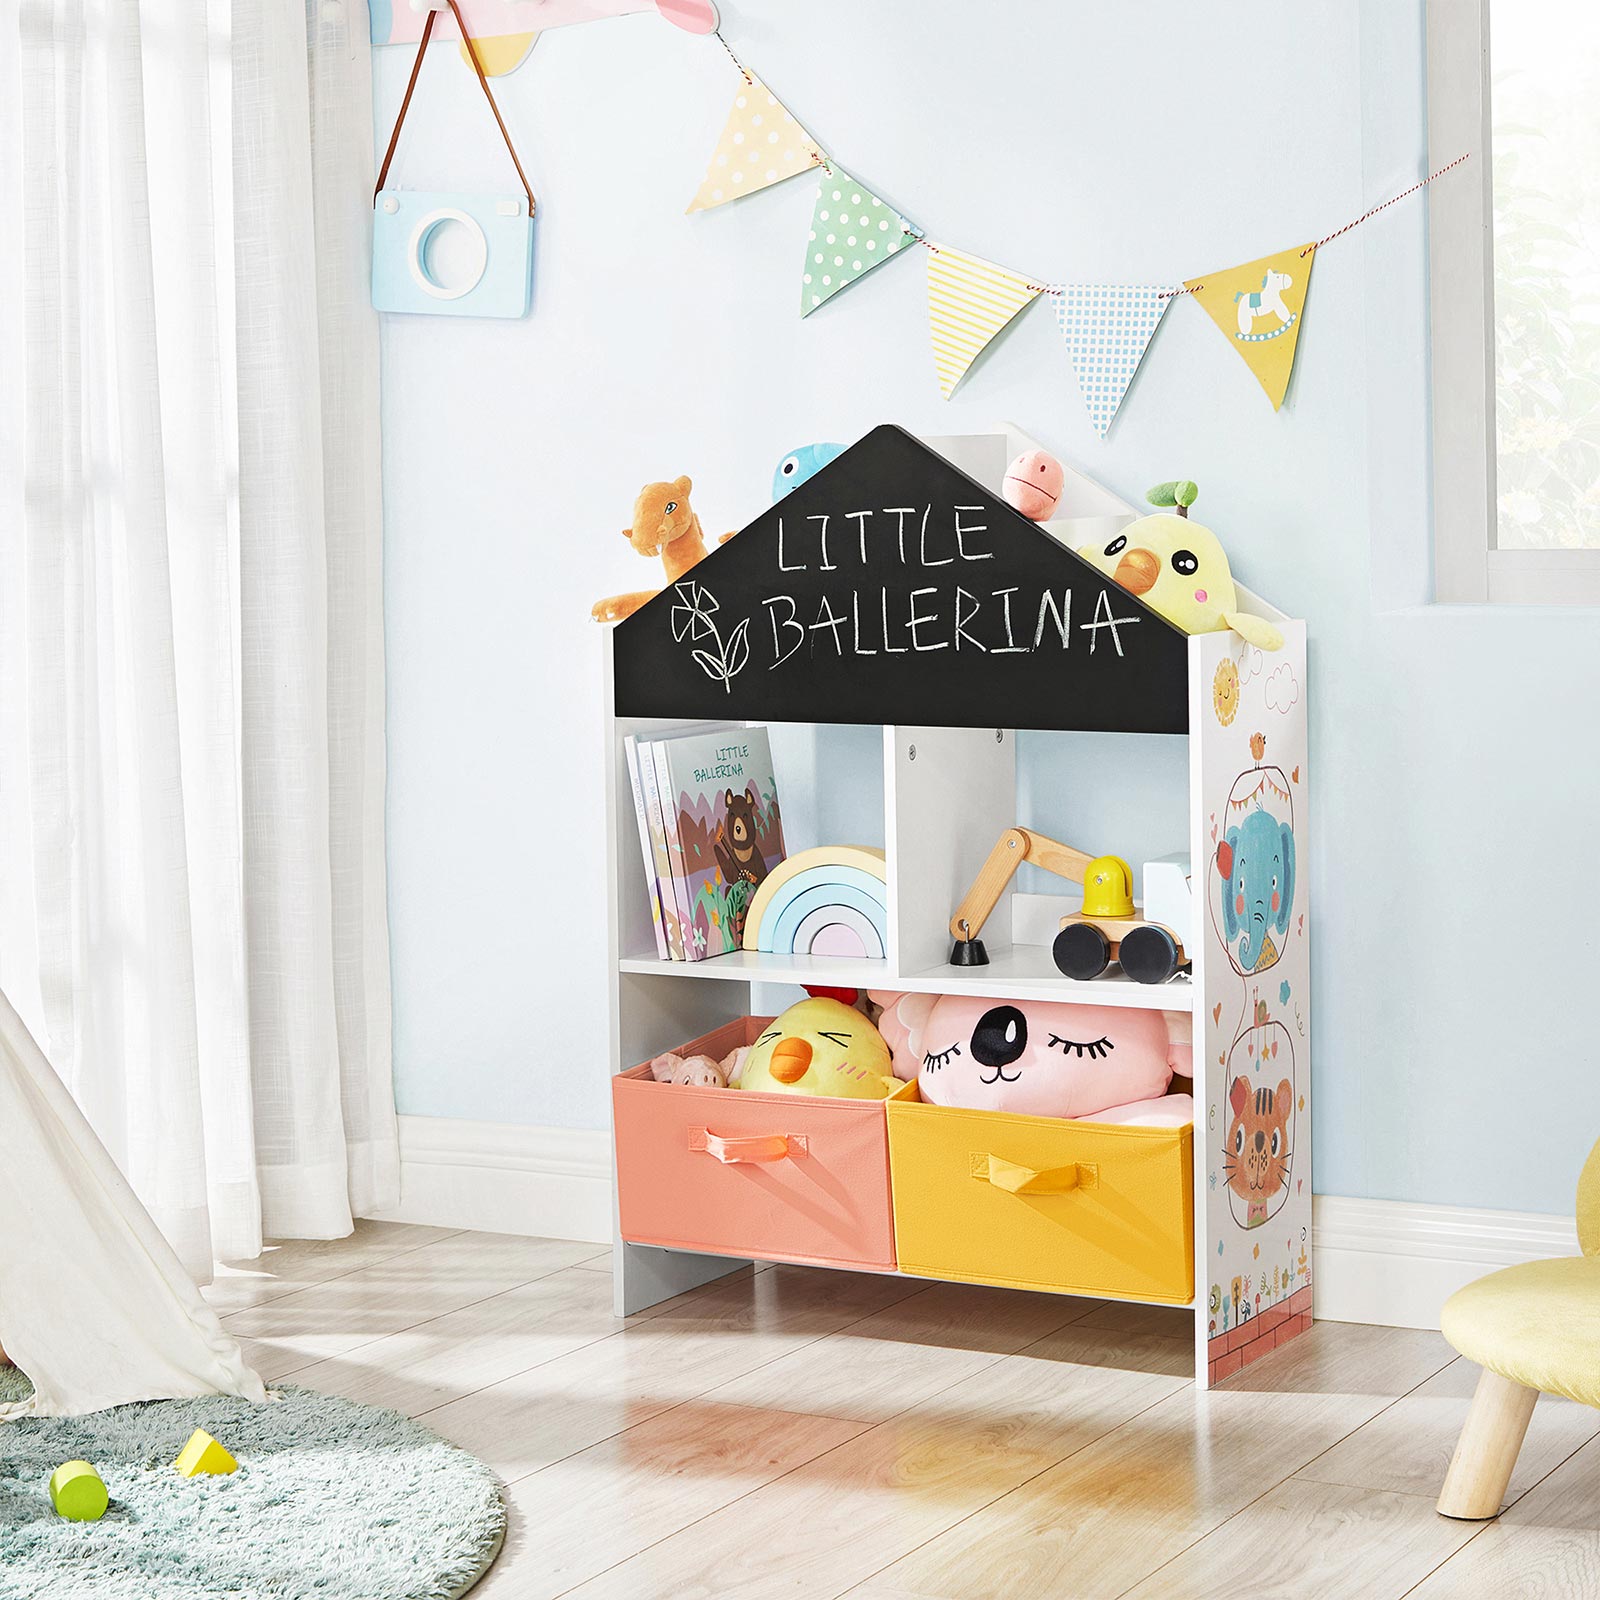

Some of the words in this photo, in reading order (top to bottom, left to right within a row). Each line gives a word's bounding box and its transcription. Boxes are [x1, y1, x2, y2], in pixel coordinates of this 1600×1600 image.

[777, 503, 995, 572] LITTLE
[762, 585, 1142, 670] BALLERINA
[693, 763, 744, 782] BALLERINA
[715, 745, 749, 761] LITTLE
